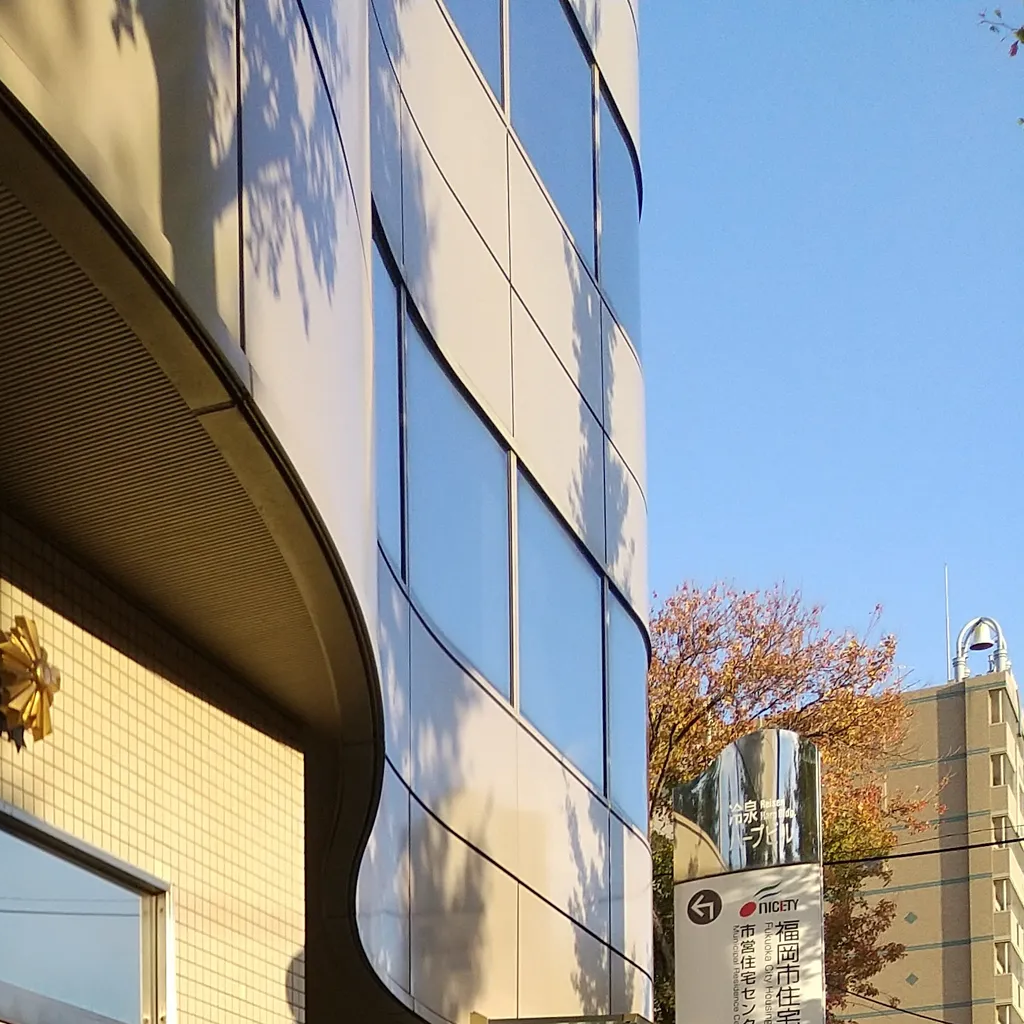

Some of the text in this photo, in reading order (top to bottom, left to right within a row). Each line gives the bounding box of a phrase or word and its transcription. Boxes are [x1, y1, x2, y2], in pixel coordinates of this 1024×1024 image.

[732, 925, 740, 965] Municipal
[764, 922, 773, 962] Fukuoka
[732, 968, 740, 1012] Residence
[764, 964, 774, 983] City
